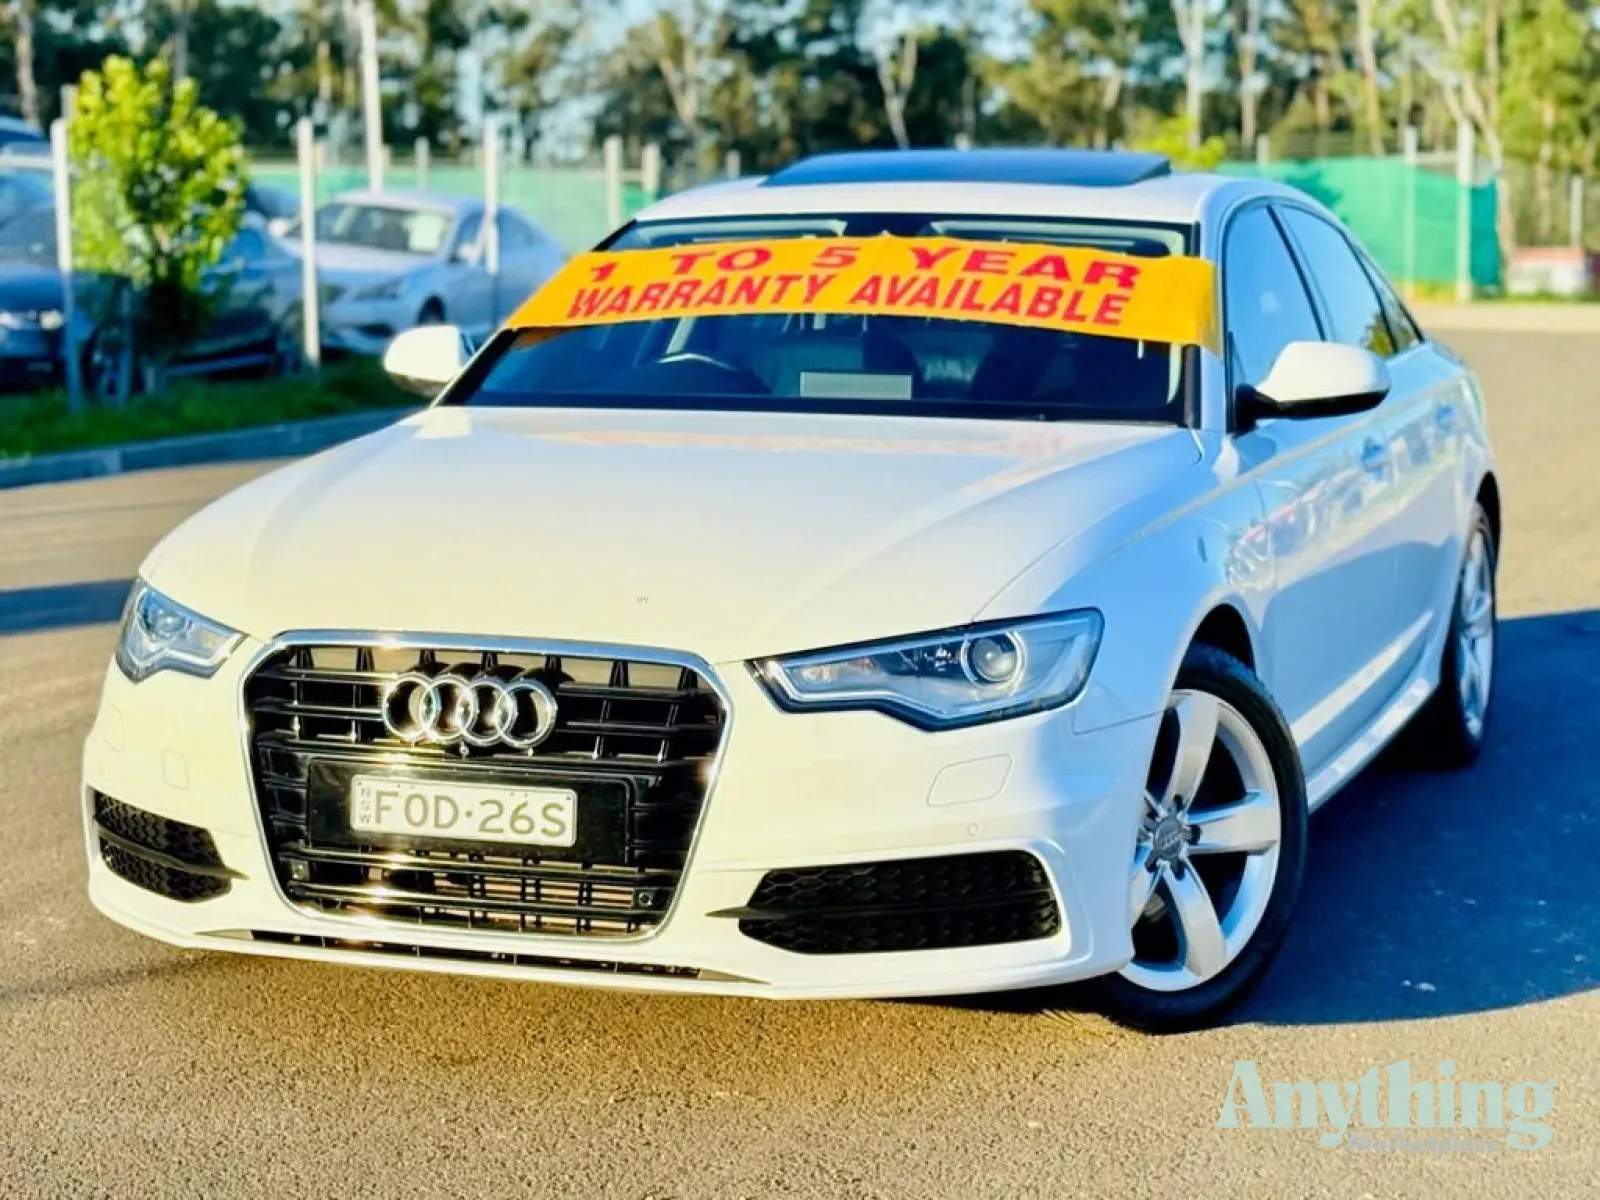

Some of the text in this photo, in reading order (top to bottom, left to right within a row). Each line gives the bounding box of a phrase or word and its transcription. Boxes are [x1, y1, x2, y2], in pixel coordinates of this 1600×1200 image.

[590, 247, 1141, 288] 1 TO 5 YEAR
[567, 274, 1131, 325] WARRANTY AVAILABLE
